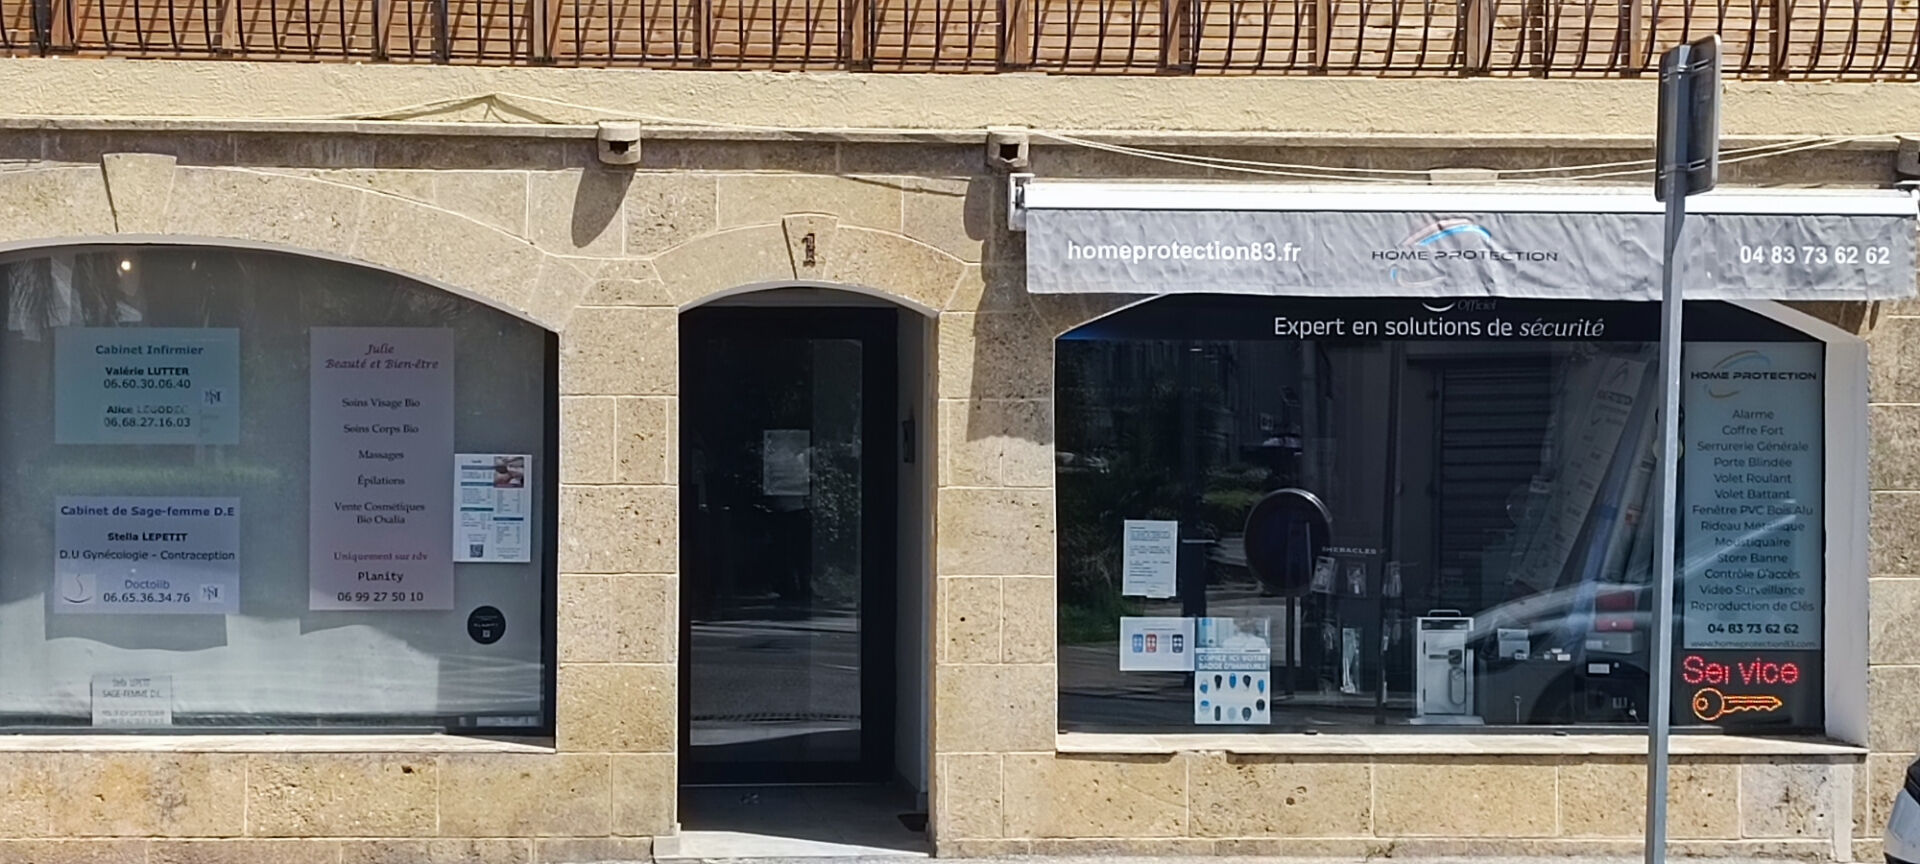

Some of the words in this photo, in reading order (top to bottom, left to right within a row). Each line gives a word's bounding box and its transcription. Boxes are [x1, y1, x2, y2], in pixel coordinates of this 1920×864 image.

[1067, 240, 1301, 264] homeprotection83.fr
[1371, 250, 1428, 260] HOME
[1434, 250, 1558, 262] PROTECTION
[1739, 246, 1764, 264] 04
[1771, 246, 1795, 264] 83
[1802, 246, 1828, 264] 73
[1834, 246, 1858, 264] 62
[1865, 246, 1890, 264] 62
[1274, 317, 1345, 340] Expert
[1352, 321, 1378, 336] en
[1385, 316, 1480, 336] solutions
[1487, 317, 1513, 336] de
[1519, 318, 1604, 337] sécurité
[96, 345, 142, 355] Cabinet
[147, 345, 204, 355] Infirmier
[365, 343, 395, 355] Julie
[325, 358, 367, 369] Beauté
[370, 360, 380, 369] et
[385, 358, 439, 369] Bien-être
[105, 366, 144, 376] Valérie
[148, 367, 189, 376] LUTTER
[1690, 371, 1729, 380] HOME
[1733, 371, 1817, 380] PROTECTION
[103, 379, 191, 389] 06.60.30.06.40
[106, 405, 134, 414] Alice
[342, 398, 368, 408] Soins
[370, 398, 402, 410] Visage
[405, 398, 421, 408] Bio
[1732, 409, 1775, 419] Alarme
[104, 417, 191, 428] 06.68.27.16.03
[343, 424, 369, 434] Soins
[372, 424, 400, 436] Corps
[403, 424, 419, 433] Bio
[1722, 425, 1758, 435] Coffre
[1760, 425, 1784, 435] Fort
[1697, 441, 1754, 451] Serrurerie
[1757, 441, 1809, 451] Générale
[358, 450, 404, 461] Massages
[1713, 457, 1746, 467] Porte
[1748, 457, 1792, 467] Blindée
[357, 475, 406, 488] Épilations
[1713, 473, 1743, 483] Volet
[1746, 473, 1792, 483] Roulant
[1714, 489, 1743, 499] Volet
[1747, 489, 1791, 499] Battant
[60, 505, 108, 516] Cabinet
[112, 505, 128, 516] de
[131, 506, 210, 518] Sage-femme
[214, 507, 235, 516] D.E
[334, 502, 362, 511] Vente
[364, 502, 425, 514] Cosmétiques
[1692, 504, 1738, 515] Fenêtre
[1740, 505, 1764, 515] PVC
[1767, 505, 1792, 515] Bois
[1794, 505, 1813, 515] Alu
[357, 515, 373, 524] Bio
[374, 514, 406, 524] Oxalia
[1701, 521, 1741, 531] Rideau
[1744, 521, 1805, 532] Métque
[107, 532, 139, 541] Stella
[142, 532, 188, 541] LEPETIT
[59, 551, 80, 560] D.U
[83, 550, 149, 561] Gynécologie
[160, 550, 235, 561] Contraception
[334, 552, 393, 562] Uniquement
[411, 552, 428, 560] rdv
[1718, 553, 1747, 563] Store
[1750, 553, 1788, 563] Banne
[358, 571, 404, 583] Planity
[1704, 568, 1754, 579] Contrôle
[1757, 568, 1801, 579] D'accès
[125, 580, 170, 590] Doctolib
[1699, 584, 1733, 595] Vidéo
[1735, 584, 1805, 595] Surveillance
[103, 593, 191, 603] 06.65.36.34.76
[337, 592, 352, 602] 06
[355, 592, 370, 602] 99
[373, 592, 388, 602] 27
[392, 592, 406, 602] 50
[410, 592, 424, 602] 10
[1690, 601, 1770, 612] Reproduction
[1772, 601, 1788, 611] de
[1790, 601, 1815, 611] Clés
[1707, 623, 1724, 634] 04
[1728, 623, 1743, 634] 83
[1747, 623, 1762, 634] 73
[1765, 623, 1781, 634] 62
[1784, 623, 1799, 634] 62
